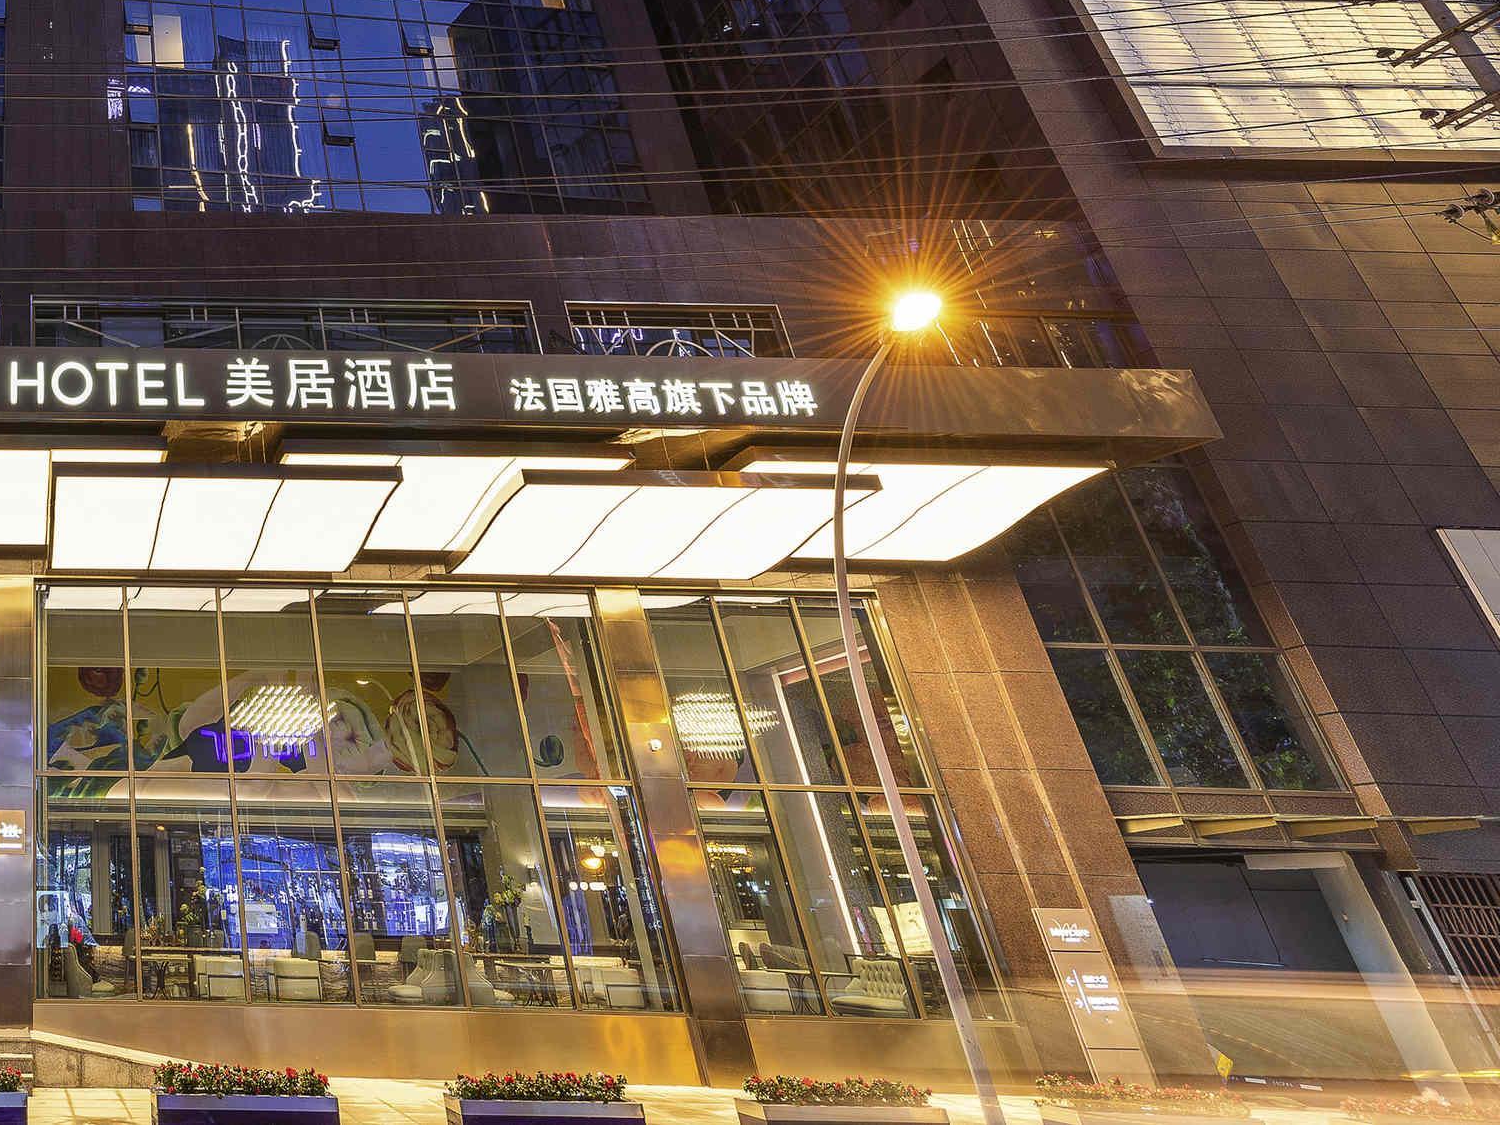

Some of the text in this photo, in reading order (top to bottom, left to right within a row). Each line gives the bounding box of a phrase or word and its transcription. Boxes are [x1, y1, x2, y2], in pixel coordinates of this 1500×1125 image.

[9, 361, 205, 407] HOTEL
[226, 357, 456, 410] 美居酒店
[509, 377, 819, 417] 法国雅高旗下品牌
